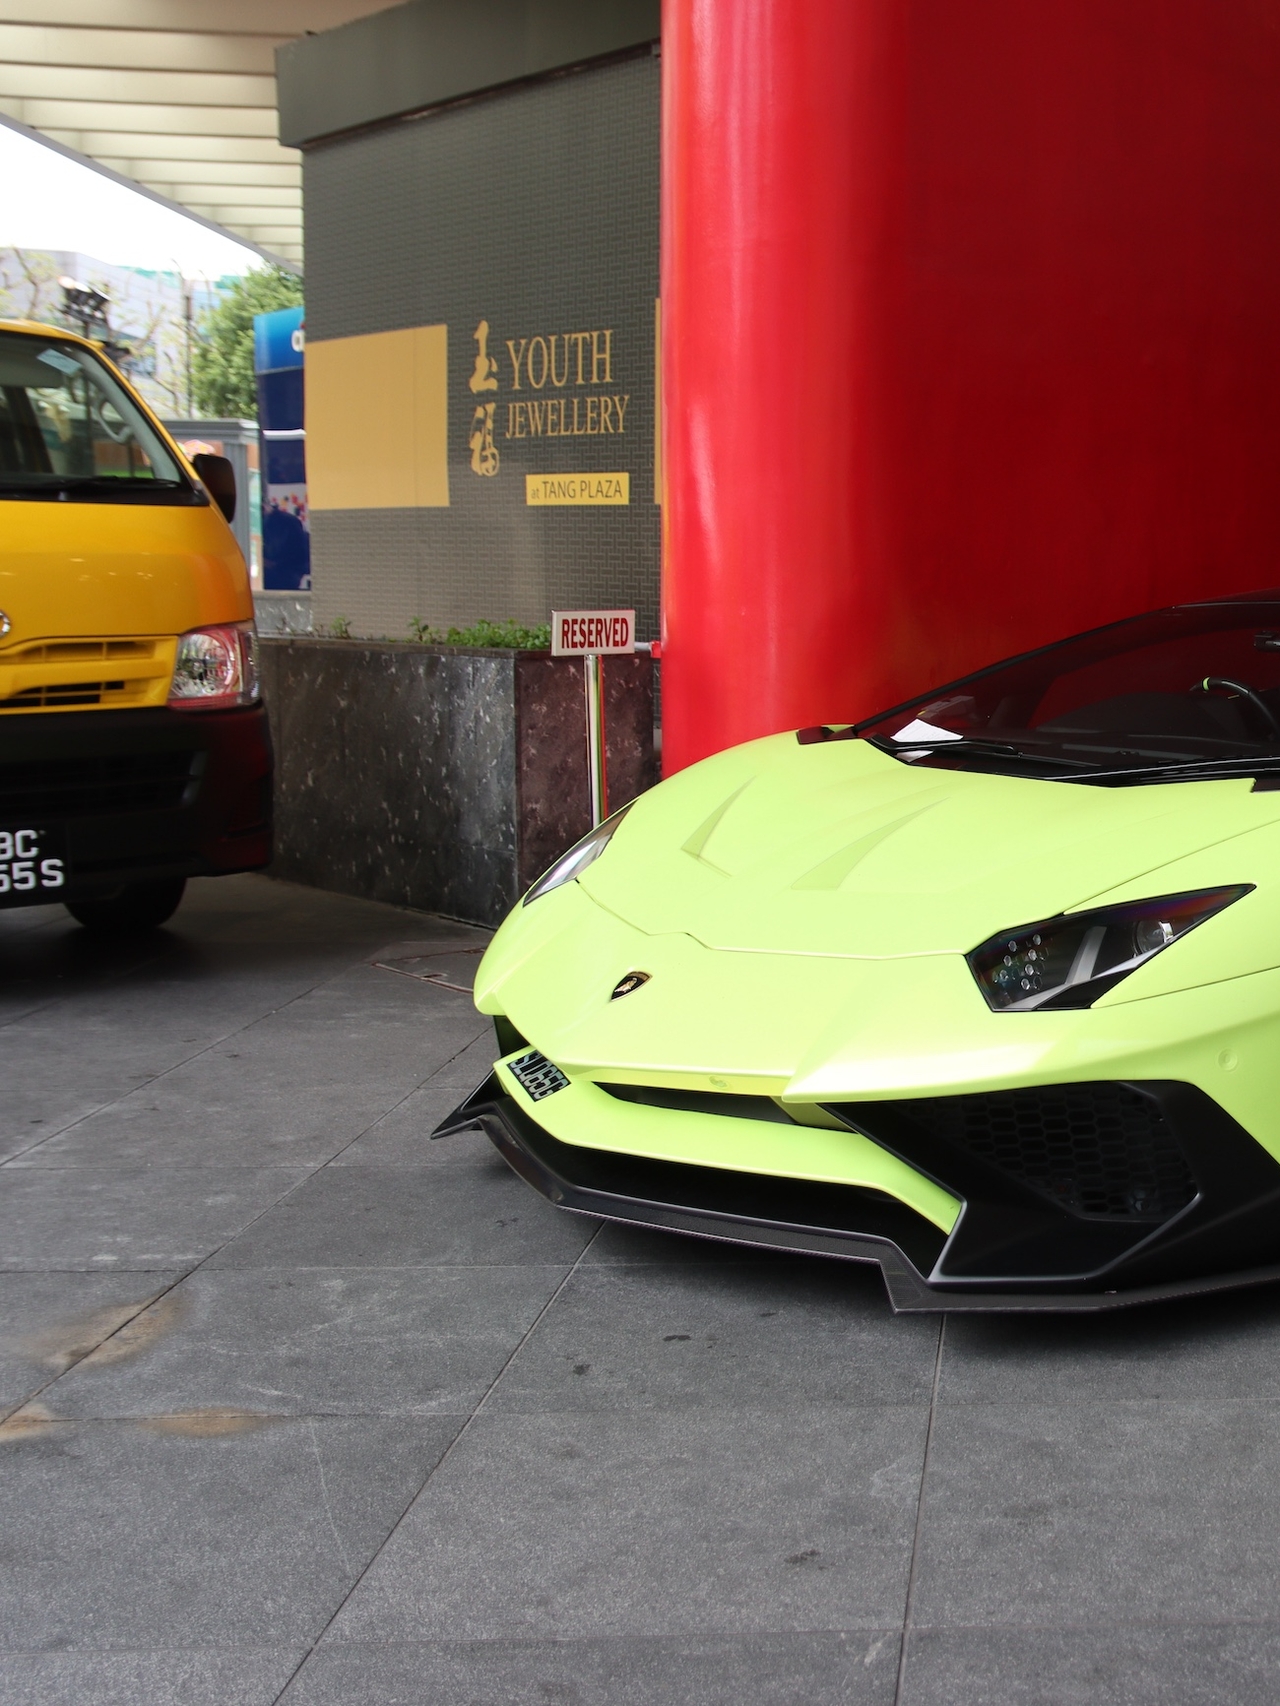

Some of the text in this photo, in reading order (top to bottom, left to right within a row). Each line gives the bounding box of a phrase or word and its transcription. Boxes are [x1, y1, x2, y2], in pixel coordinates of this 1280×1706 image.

[505, 329, 613, 389] YOUTH
[505, 394, 630, 439] JEWELLERY
[530, 479, 623, 499] at TANG PLAZA
[561, 617, 629, 649] RESERVED
